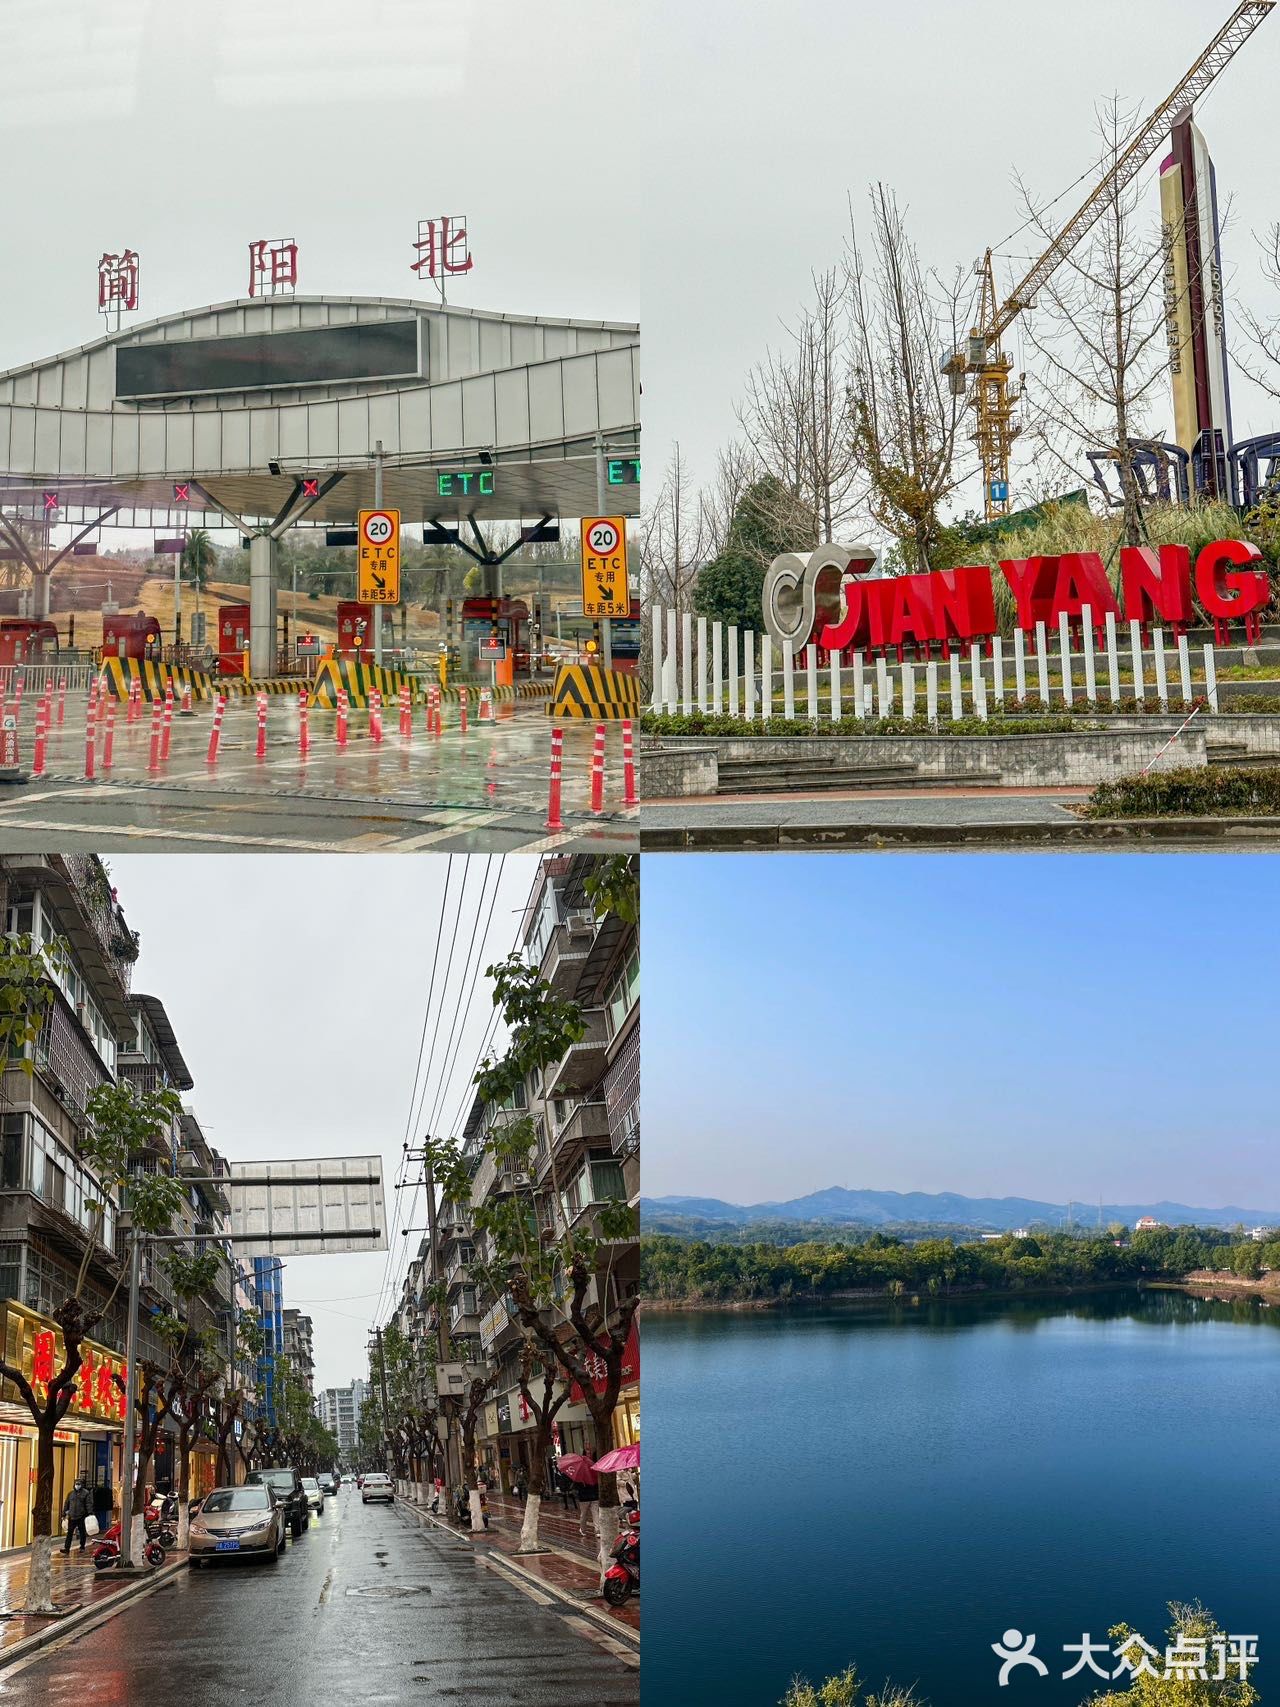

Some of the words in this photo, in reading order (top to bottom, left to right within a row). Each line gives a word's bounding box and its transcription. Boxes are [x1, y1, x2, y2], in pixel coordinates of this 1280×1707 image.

[98, 216, 473, 310] 简阳北
[438, 471, 494, 497] ETC
[370, 522, 388, 536] 20
[593, 530, 613, 546] 20
[361, 547, 395, 559] ETC
[370, 560, 387, 571] 专用
[587, 557, 621, 570] ETC
[594, 571, 615, 583] 专用
[361, 588, 396, 601] 车距5米
[820, 565, 997, 651] JIAN
[998, 539, 1270, 633] YANG
[586, 602, 625, 615] 车距5米
